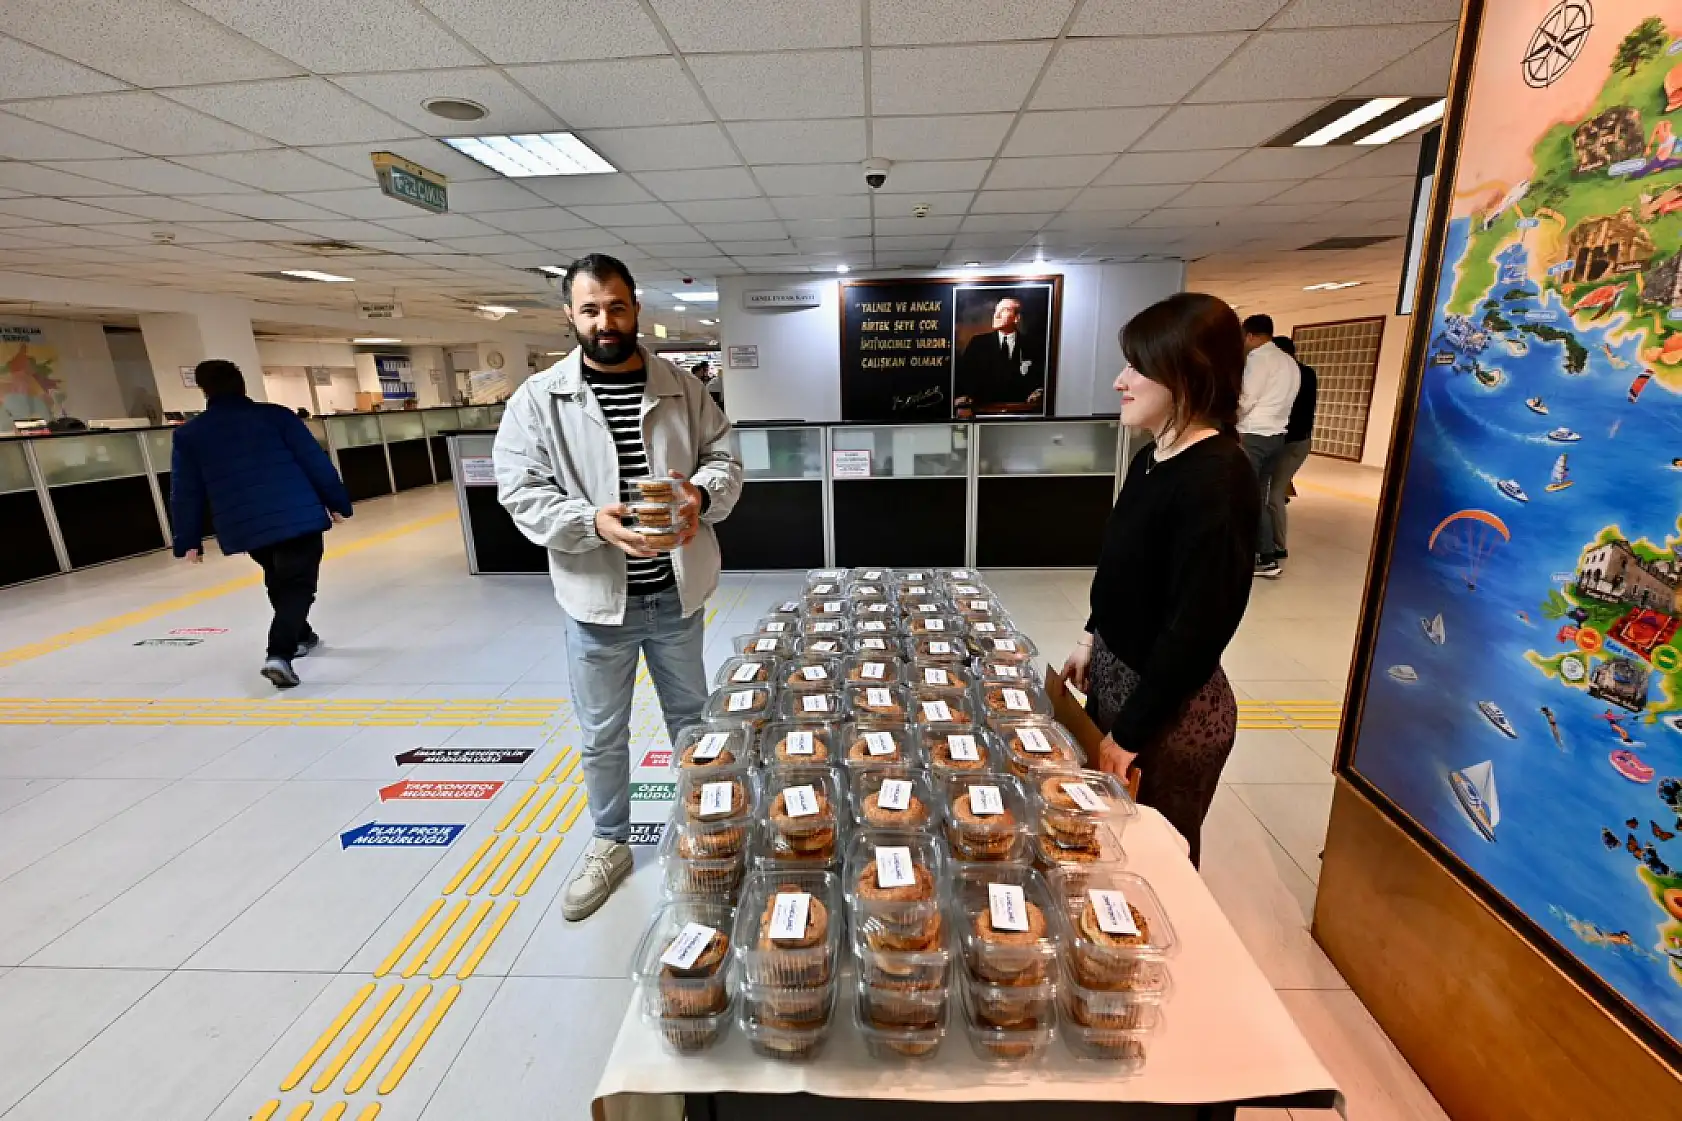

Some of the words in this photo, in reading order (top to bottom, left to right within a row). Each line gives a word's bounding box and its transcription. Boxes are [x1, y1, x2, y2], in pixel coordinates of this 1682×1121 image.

[896, 301, 907, 312] VE
[910, 300, 943, 312] ANCAK
[435, 783, 495, 791] KONTROL
[638, 783, 670, 792] ÖZEL
[367, 826, 408, 835] PLAN
[408, 826, 455, 835] PROJE
